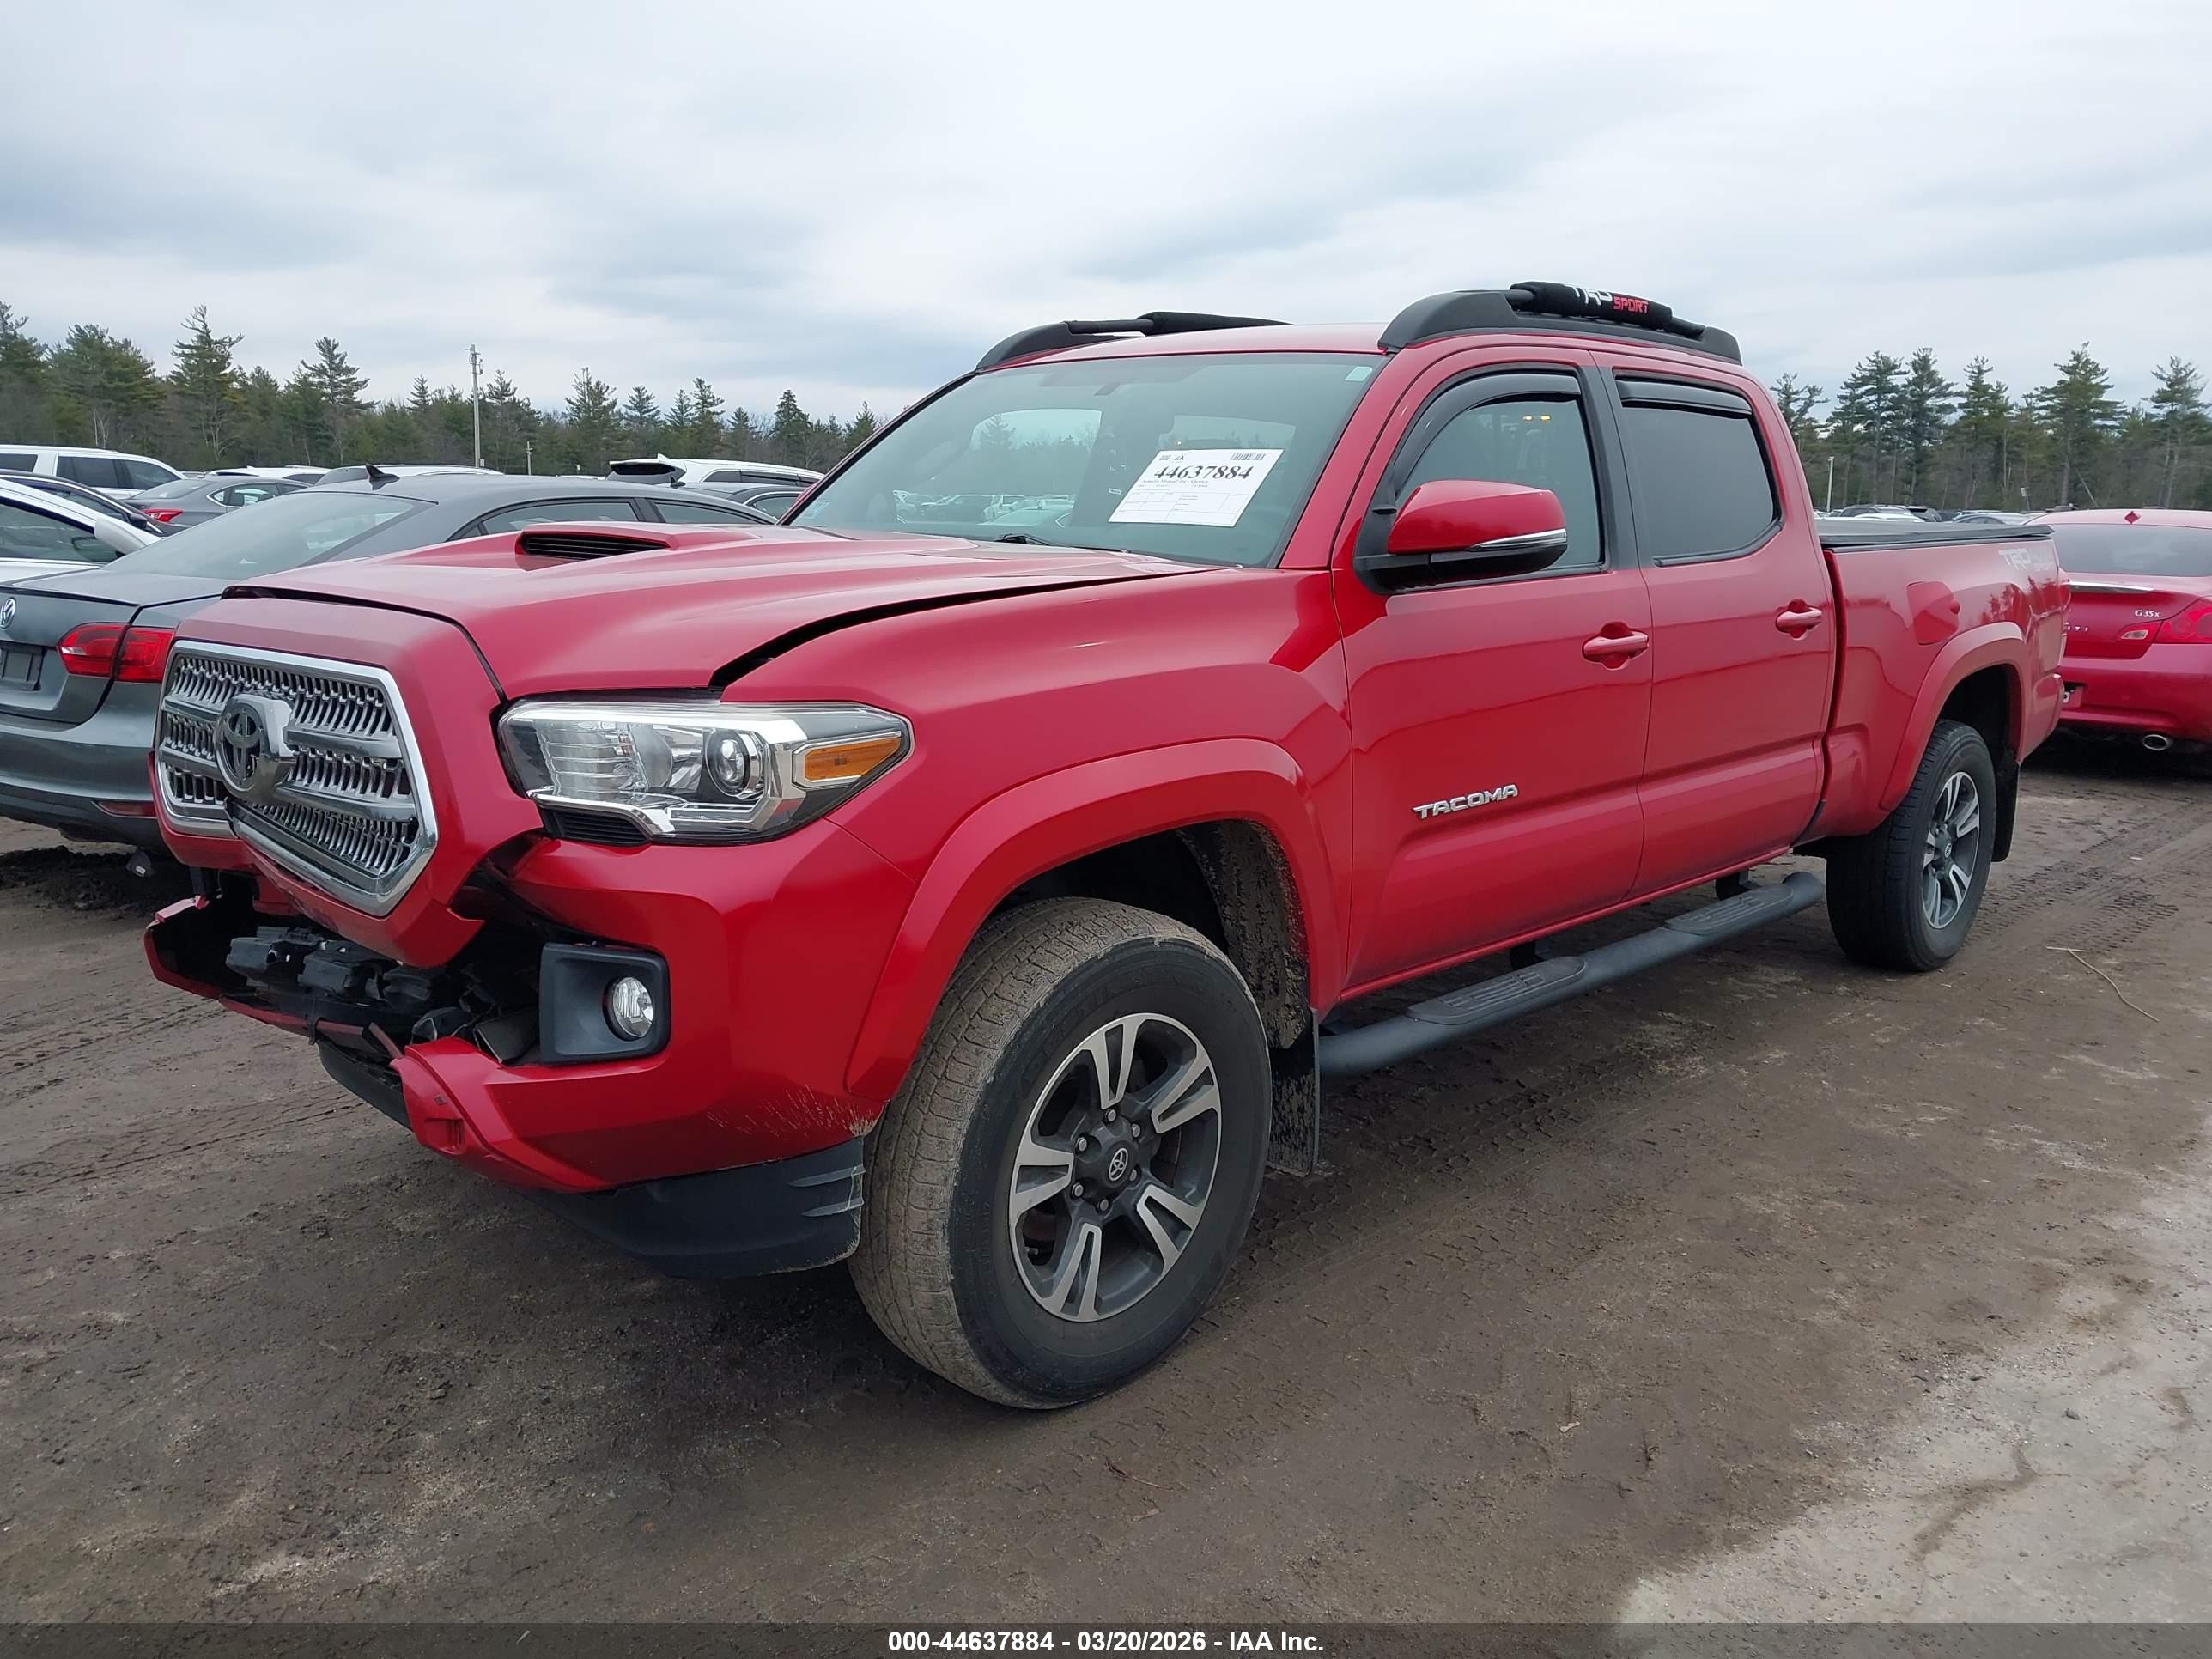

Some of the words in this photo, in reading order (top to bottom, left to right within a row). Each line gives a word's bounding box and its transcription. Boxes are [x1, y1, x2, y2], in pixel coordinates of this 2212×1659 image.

[1613, 296, 1649, 313] SPORT
[1154, 465, 1254, 478] 44637884
[1998, 548, 2031, 570] TRD
[1413, 784, 1518, 818] TACOMA
